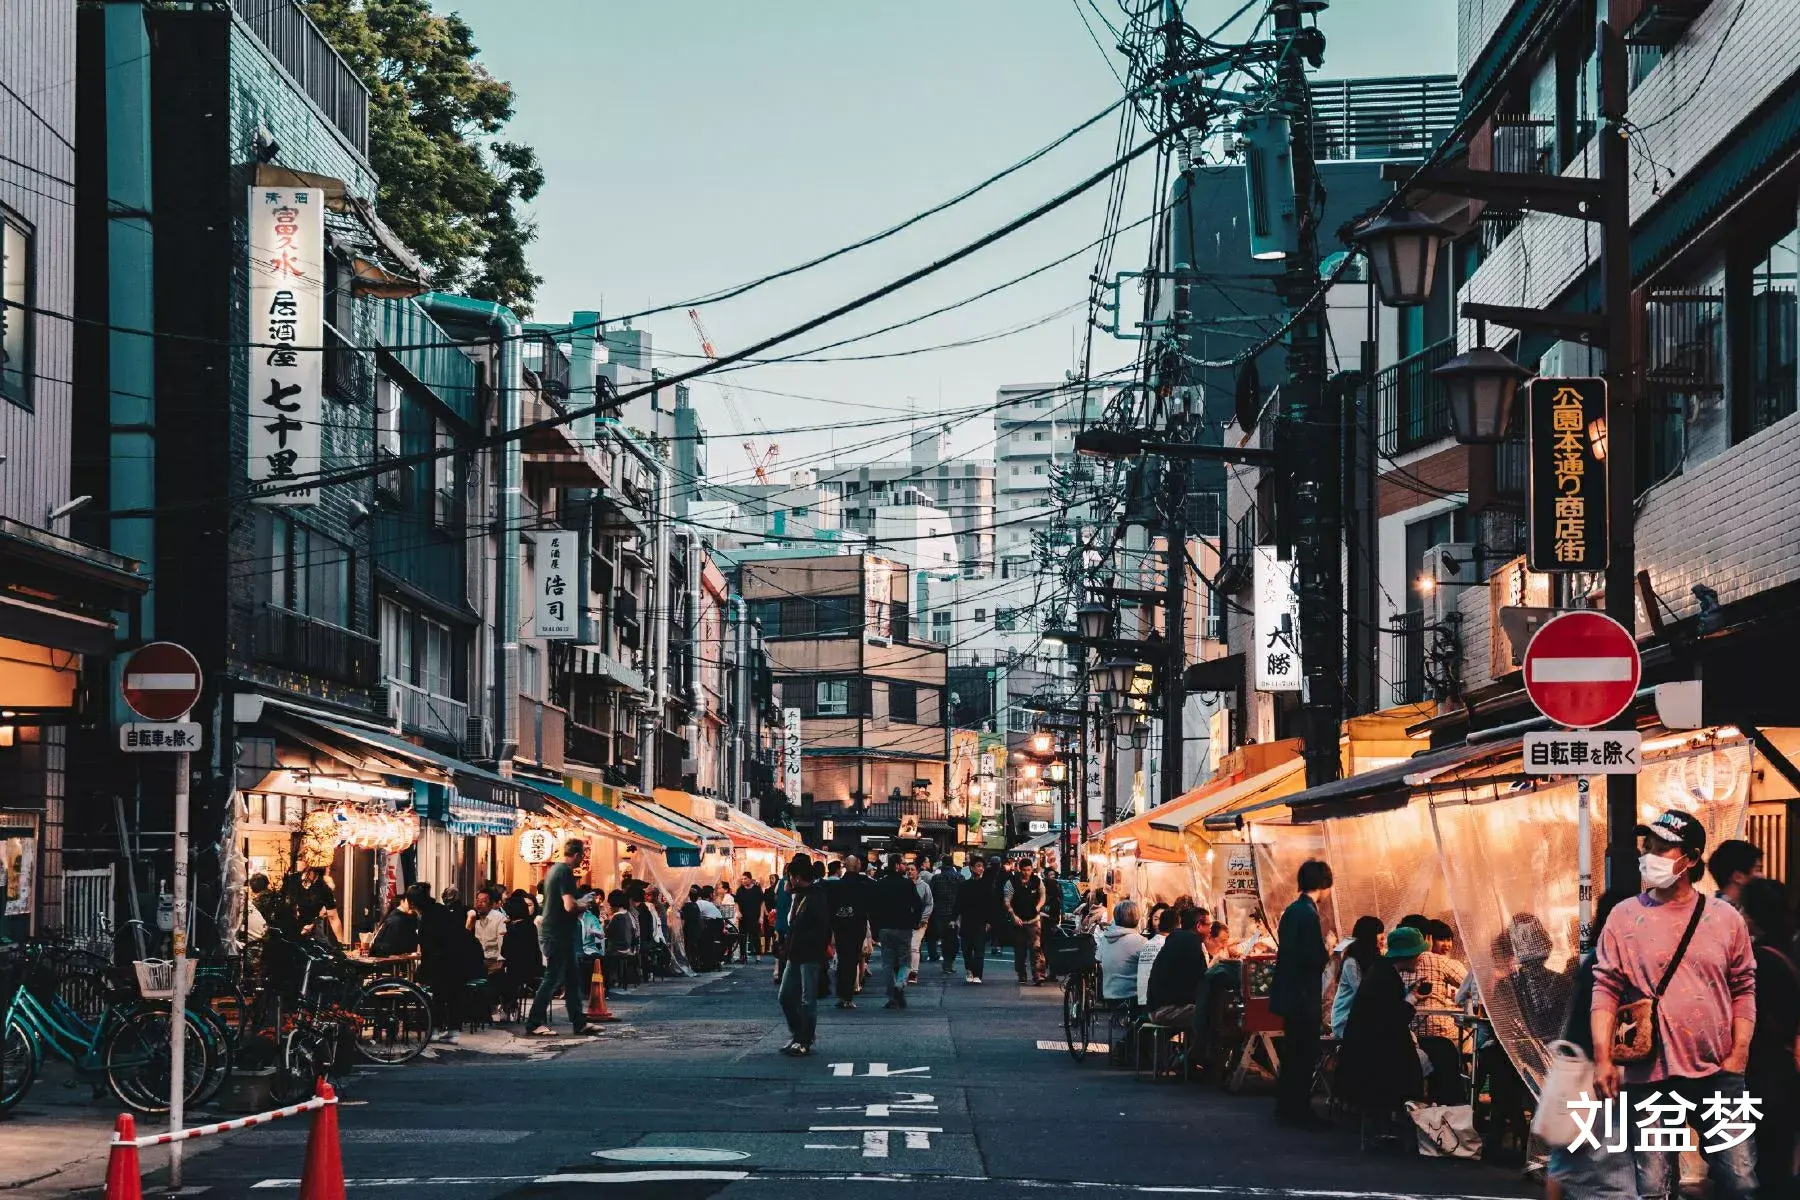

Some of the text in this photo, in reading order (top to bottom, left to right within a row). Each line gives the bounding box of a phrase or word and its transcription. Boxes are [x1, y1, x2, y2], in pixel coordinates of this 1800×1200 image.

[267, 290, 298, 367] 居酒屋
[1553, 387, 1586, 562] 公園本通り商店街
[550, 538, 560, 569] 居酒屋
[545, 575, 566, 622] 浩司
[1266, 626, 1291, 676] 大勝
[127, 729, 195, 747] 自転車を除く
[1531, 741, 1636, 766] 自転車を除く
[1227, 878, 1256, 889] 受賞店
